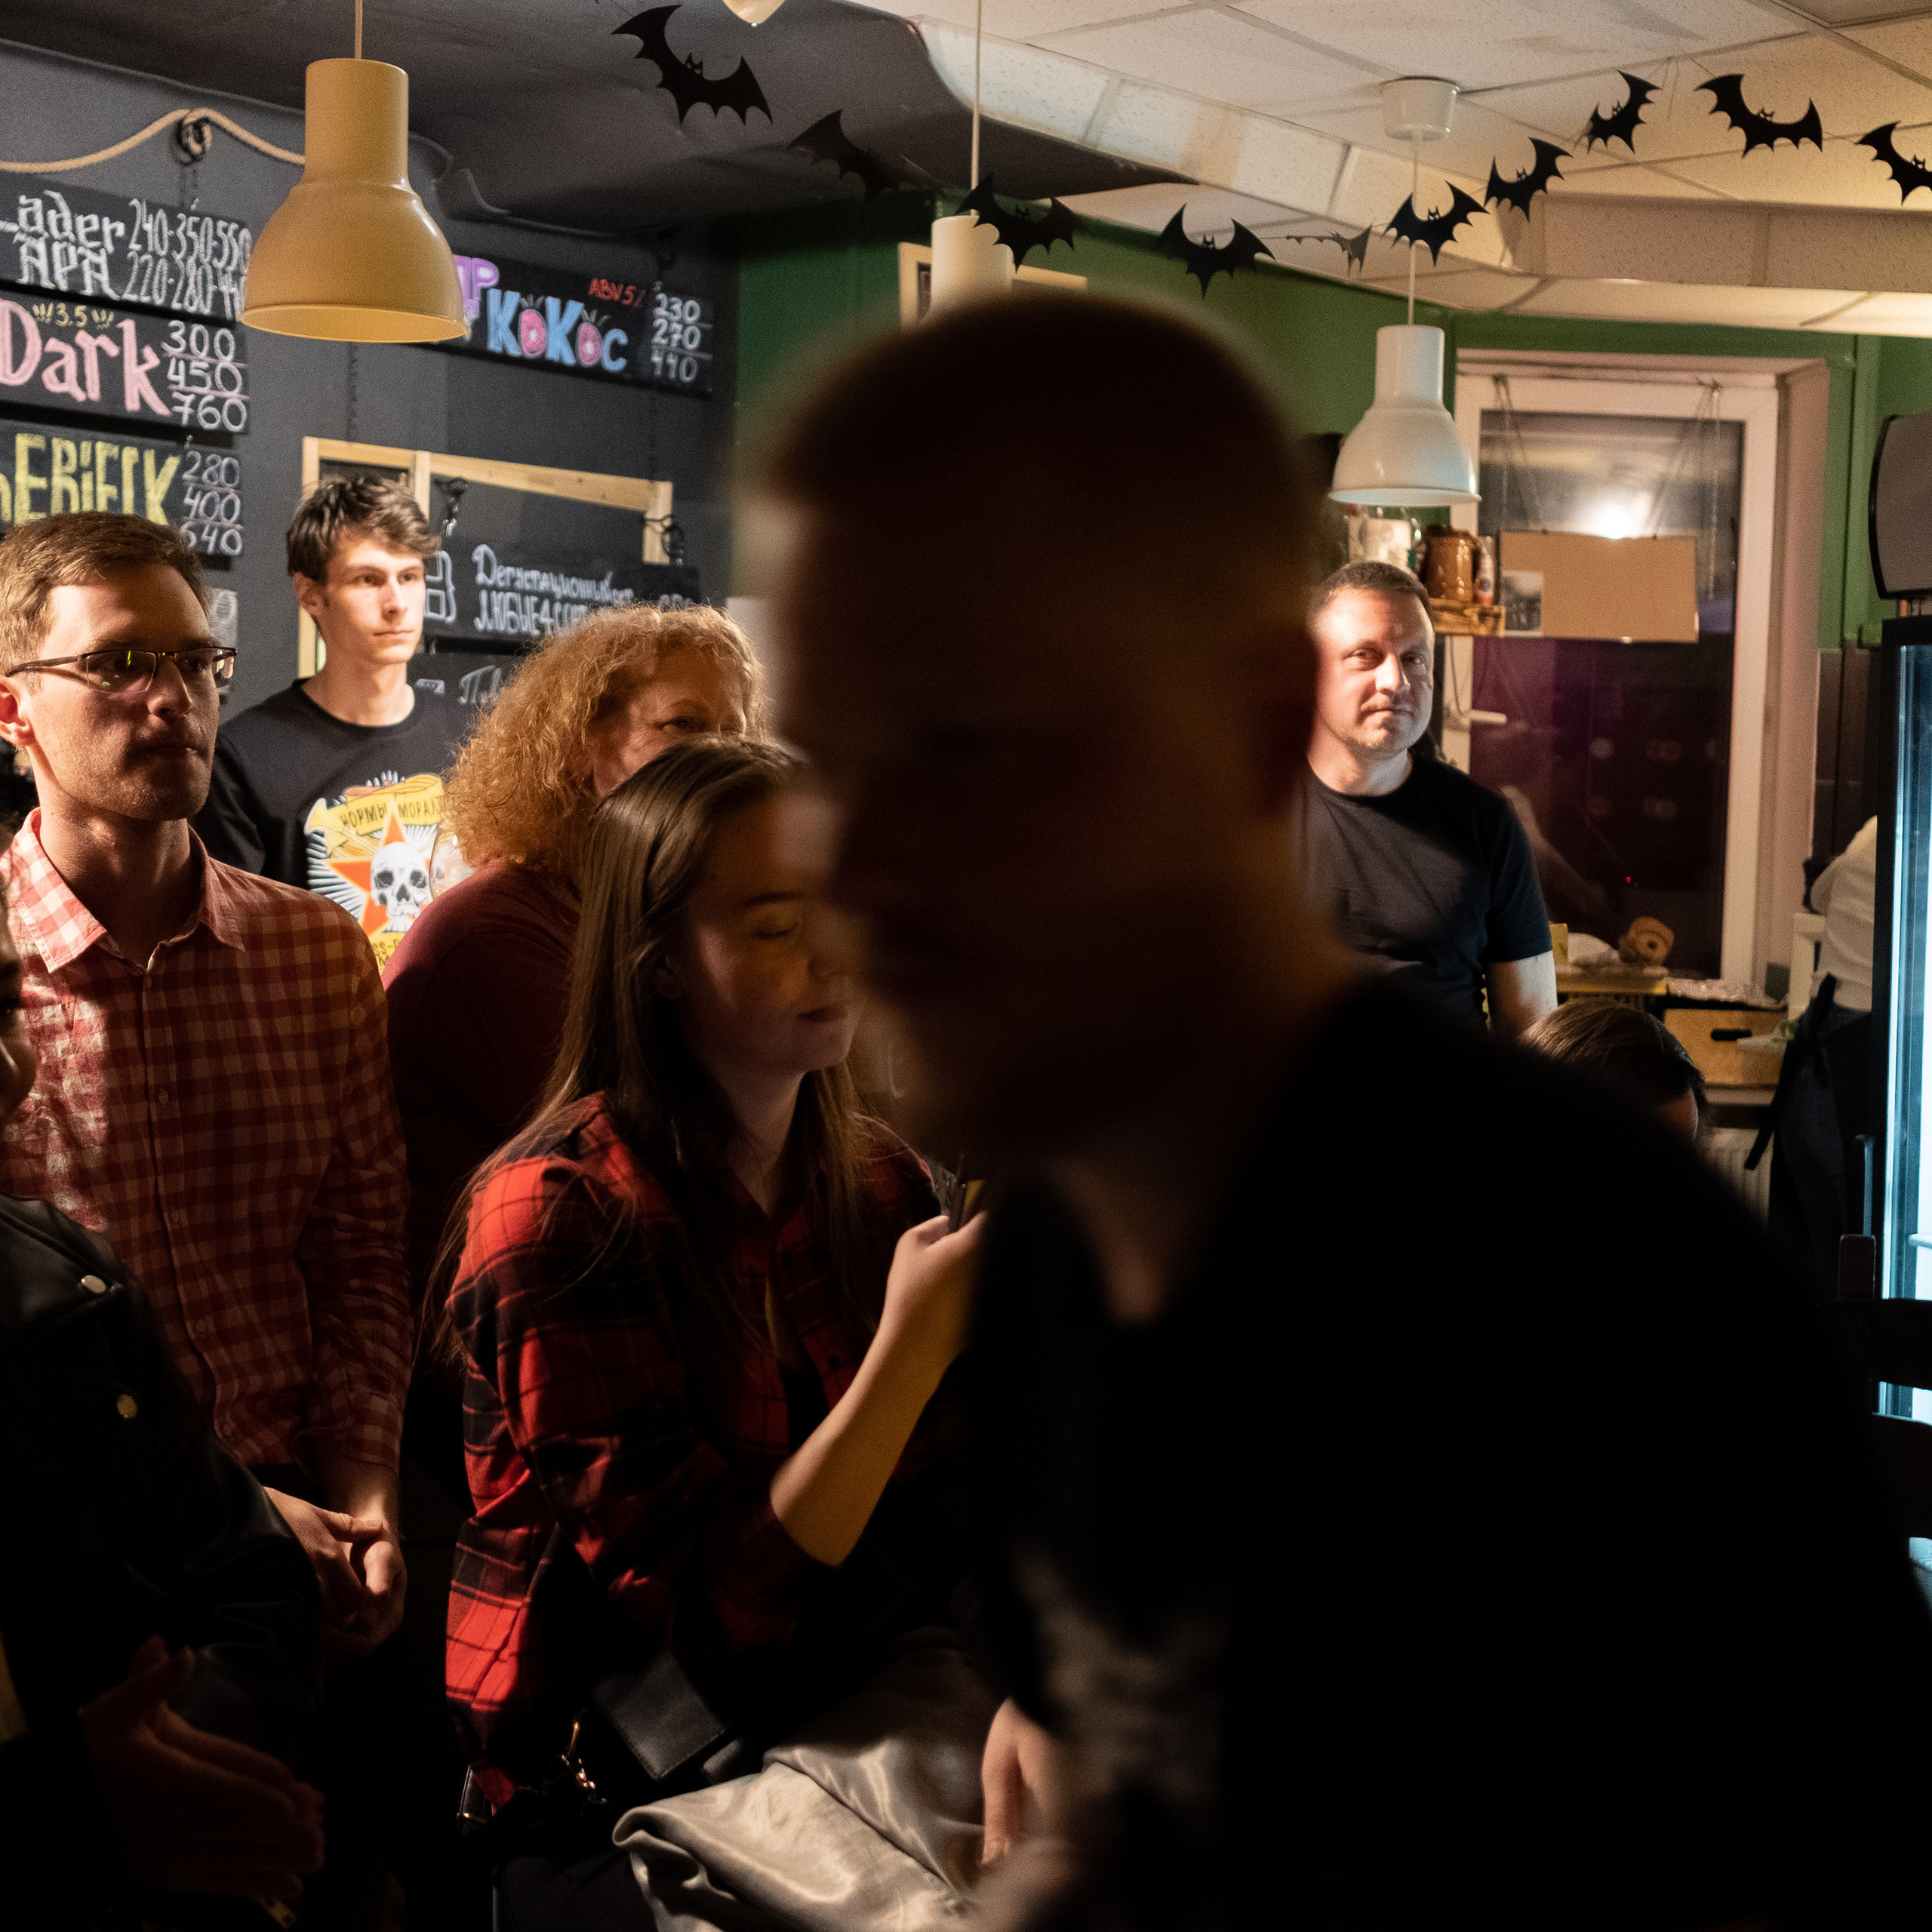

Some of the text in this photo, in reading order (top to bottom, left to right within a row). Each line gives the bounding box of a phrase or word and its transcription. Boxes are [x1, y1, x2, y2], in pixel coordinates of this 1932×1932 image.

[0, 189, 125, 254] ader
[13, 232, 121, 301] APA
[56, 303, 87, 327] 3.5
[652, 292, 701, 325] 230
[161, 320, 235, 361] 300
[651, 318, 701, 350] 270
[0, 298, 171, 417] Dark
[167, 357, 242, 394] 450
[172, 391, 248, 432] 760
[182, 451, 239, 488] 280
[184, 486, 240, 524] 400
[398, 798, 440, 818] МОРАЛ
